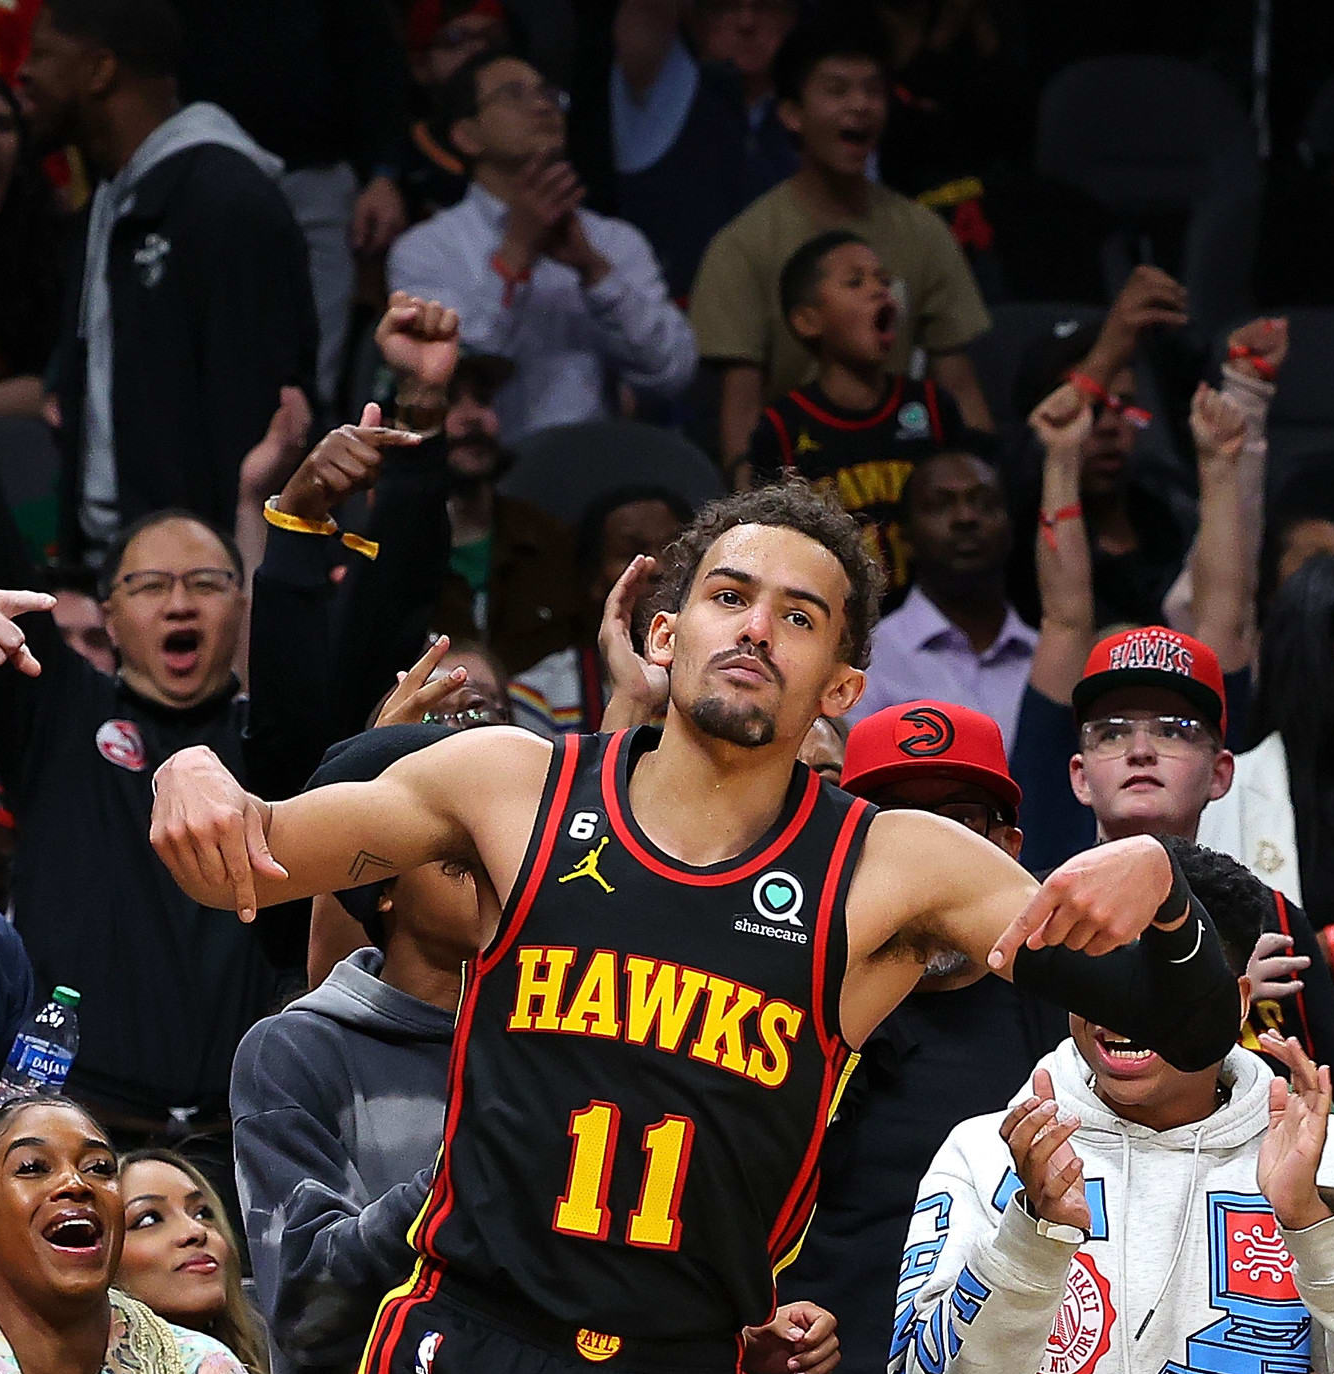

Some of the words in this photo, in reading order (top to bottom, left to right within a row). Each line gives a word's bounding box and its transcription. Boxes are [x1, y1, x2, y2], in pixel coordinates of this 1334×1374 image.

[1109, 638, 1194, 677] HAWKS
[568, 811, 599, 840] 6
[734, 917, 809, 945] sharecare
[507, 945, 806, 1089] HAWKS
[31, 1055, 69, 1076] DASAN
[552, 1099, 695, 1252] 11
